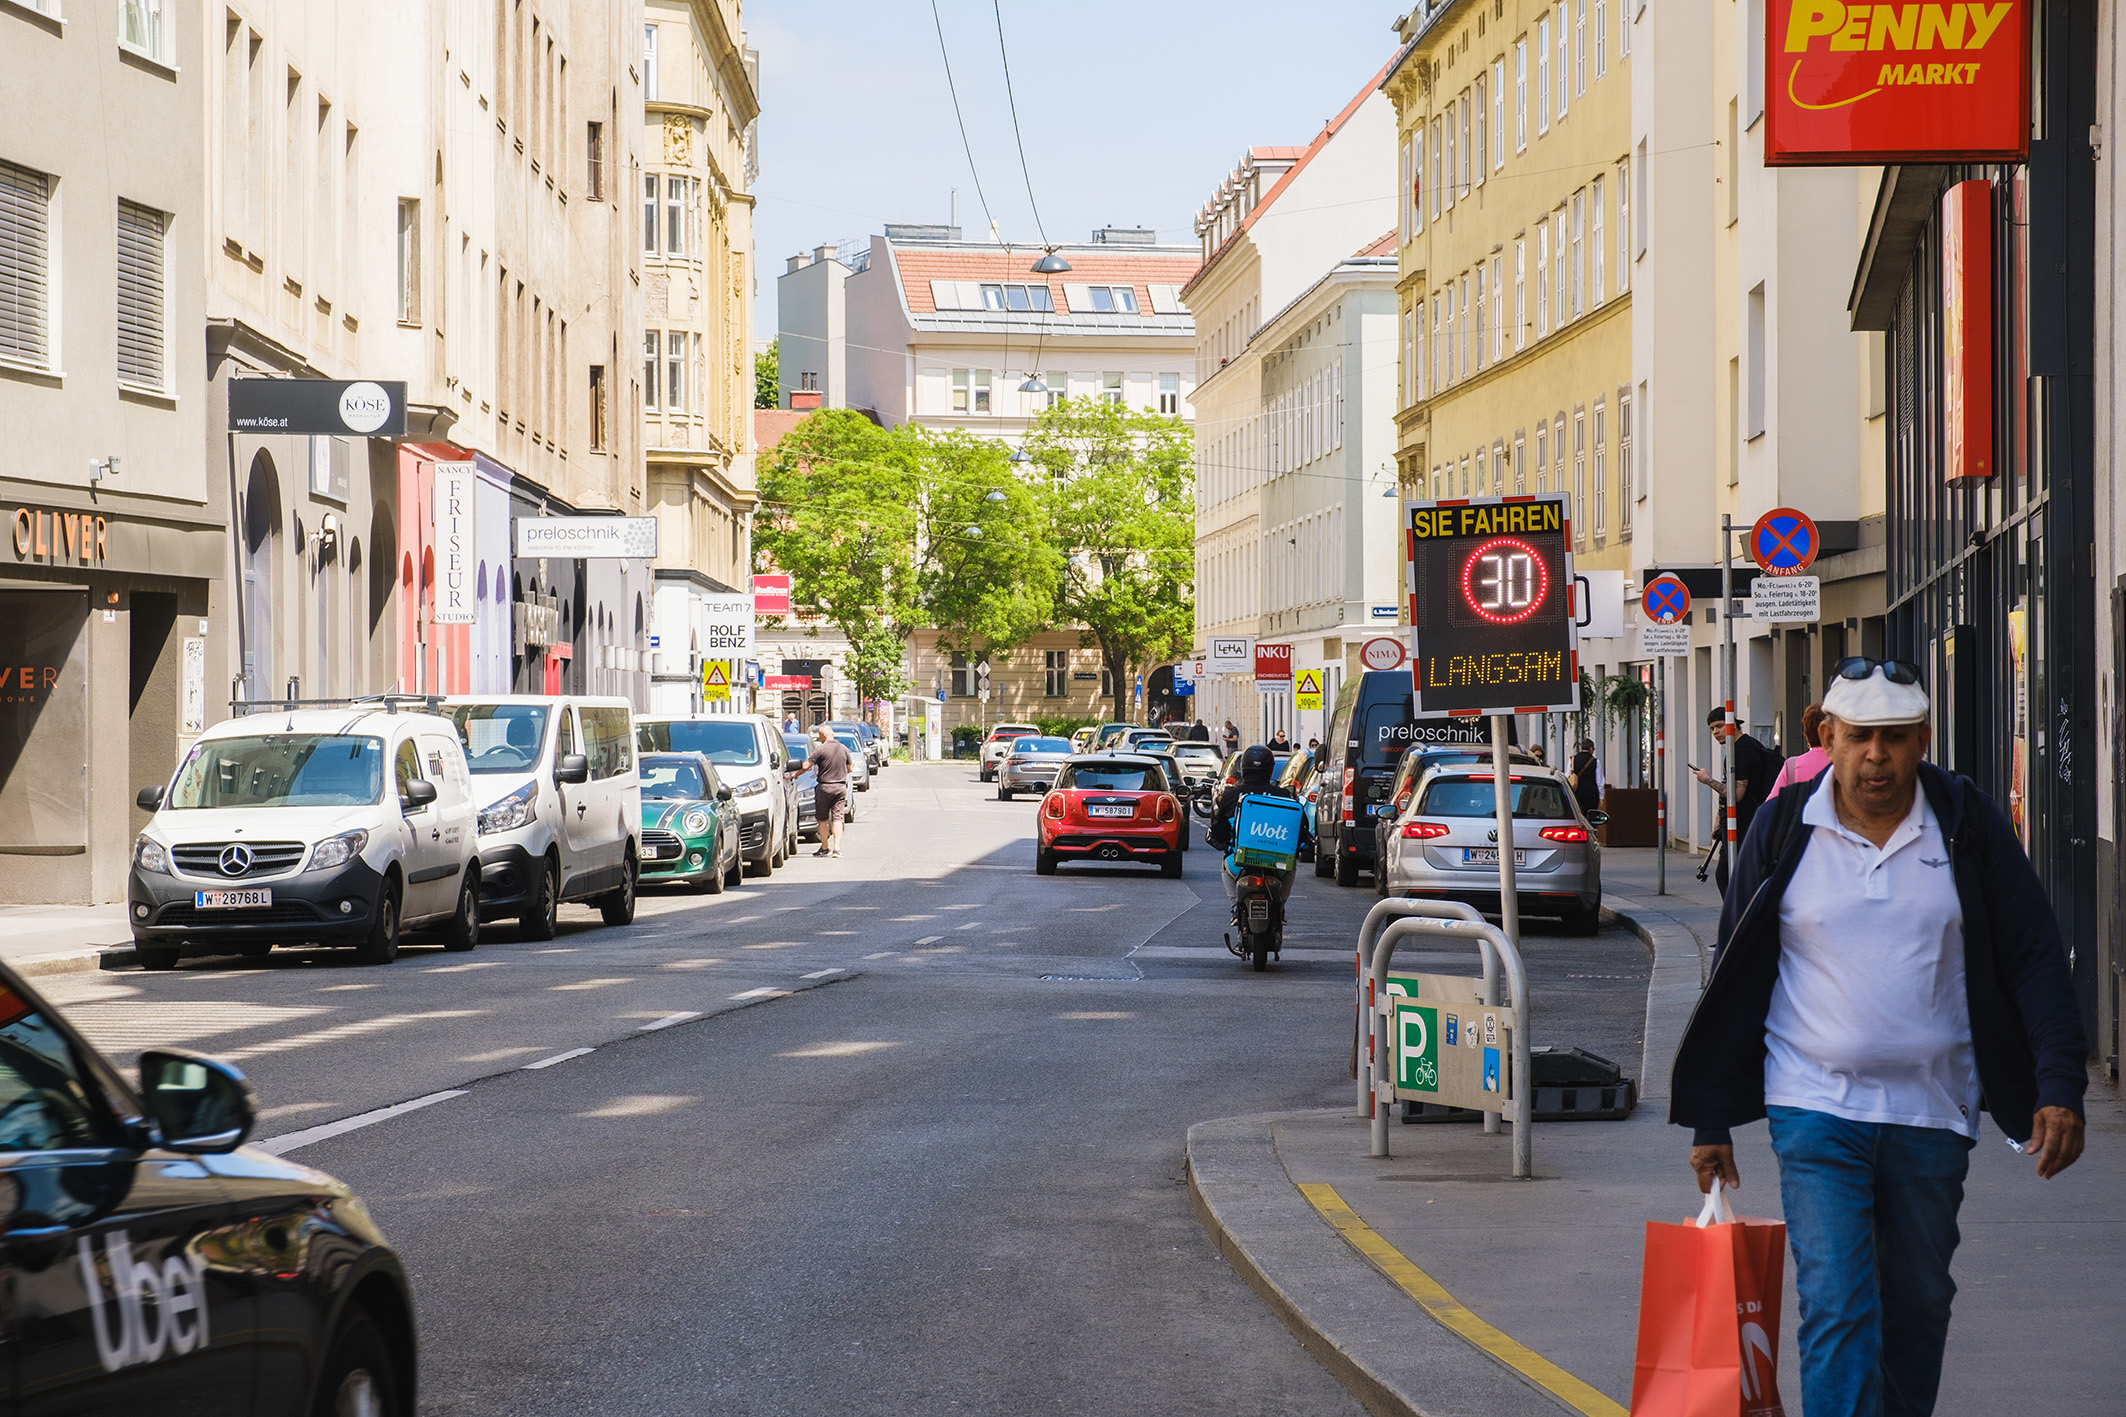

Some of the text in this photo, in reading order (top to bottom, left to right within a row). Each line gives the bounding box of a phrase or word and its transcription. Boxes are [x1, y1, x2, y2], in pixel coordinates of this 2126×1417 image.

[1784, 0, 2014, 52] PENNY
[1876, 63, 1980, 86] MARKT
[346, 396, 385, 411] KÖSE
[236, 417, 288, 427] www.köse.at
[438, 466, 472, 474] NANCY
[1415, 504, 1560, 538] SIE FAHREN
[14, 508, 106, 560] OLIVER
[528, 526, 620, 542] preloschnik
[448, 480, 462, 607] FRISEUR
[1766, 563, 1804, 576] ANFANG
[1481, 554, 1531, 608] 30
[704, 604, 751, 612] TEAM 7
[1779, 599, 1816, 608] Ladetätigkeit
[436, 612, 474, 622] STUDIO
[710, 625, 746, 636] ROLF
[710, 638, 746, 648] BENZ
[1218, 644, 1242, 654] LEHA
[1257, 647, 1289, 658] INKU
[1368, 651, 1397, 659] NIMA
[1430, 651, 1561, 687] LANGSAM
[1378, 724, 1484, 742] preloschnik
[1250, 822, 1288, 840] Wolt
[1471, 850, 1477, 859] W
[205, 894, 213, 905] W
[1400, 1011, 1427, 1081] P
[78, 1229, 209, 1372] Uber
